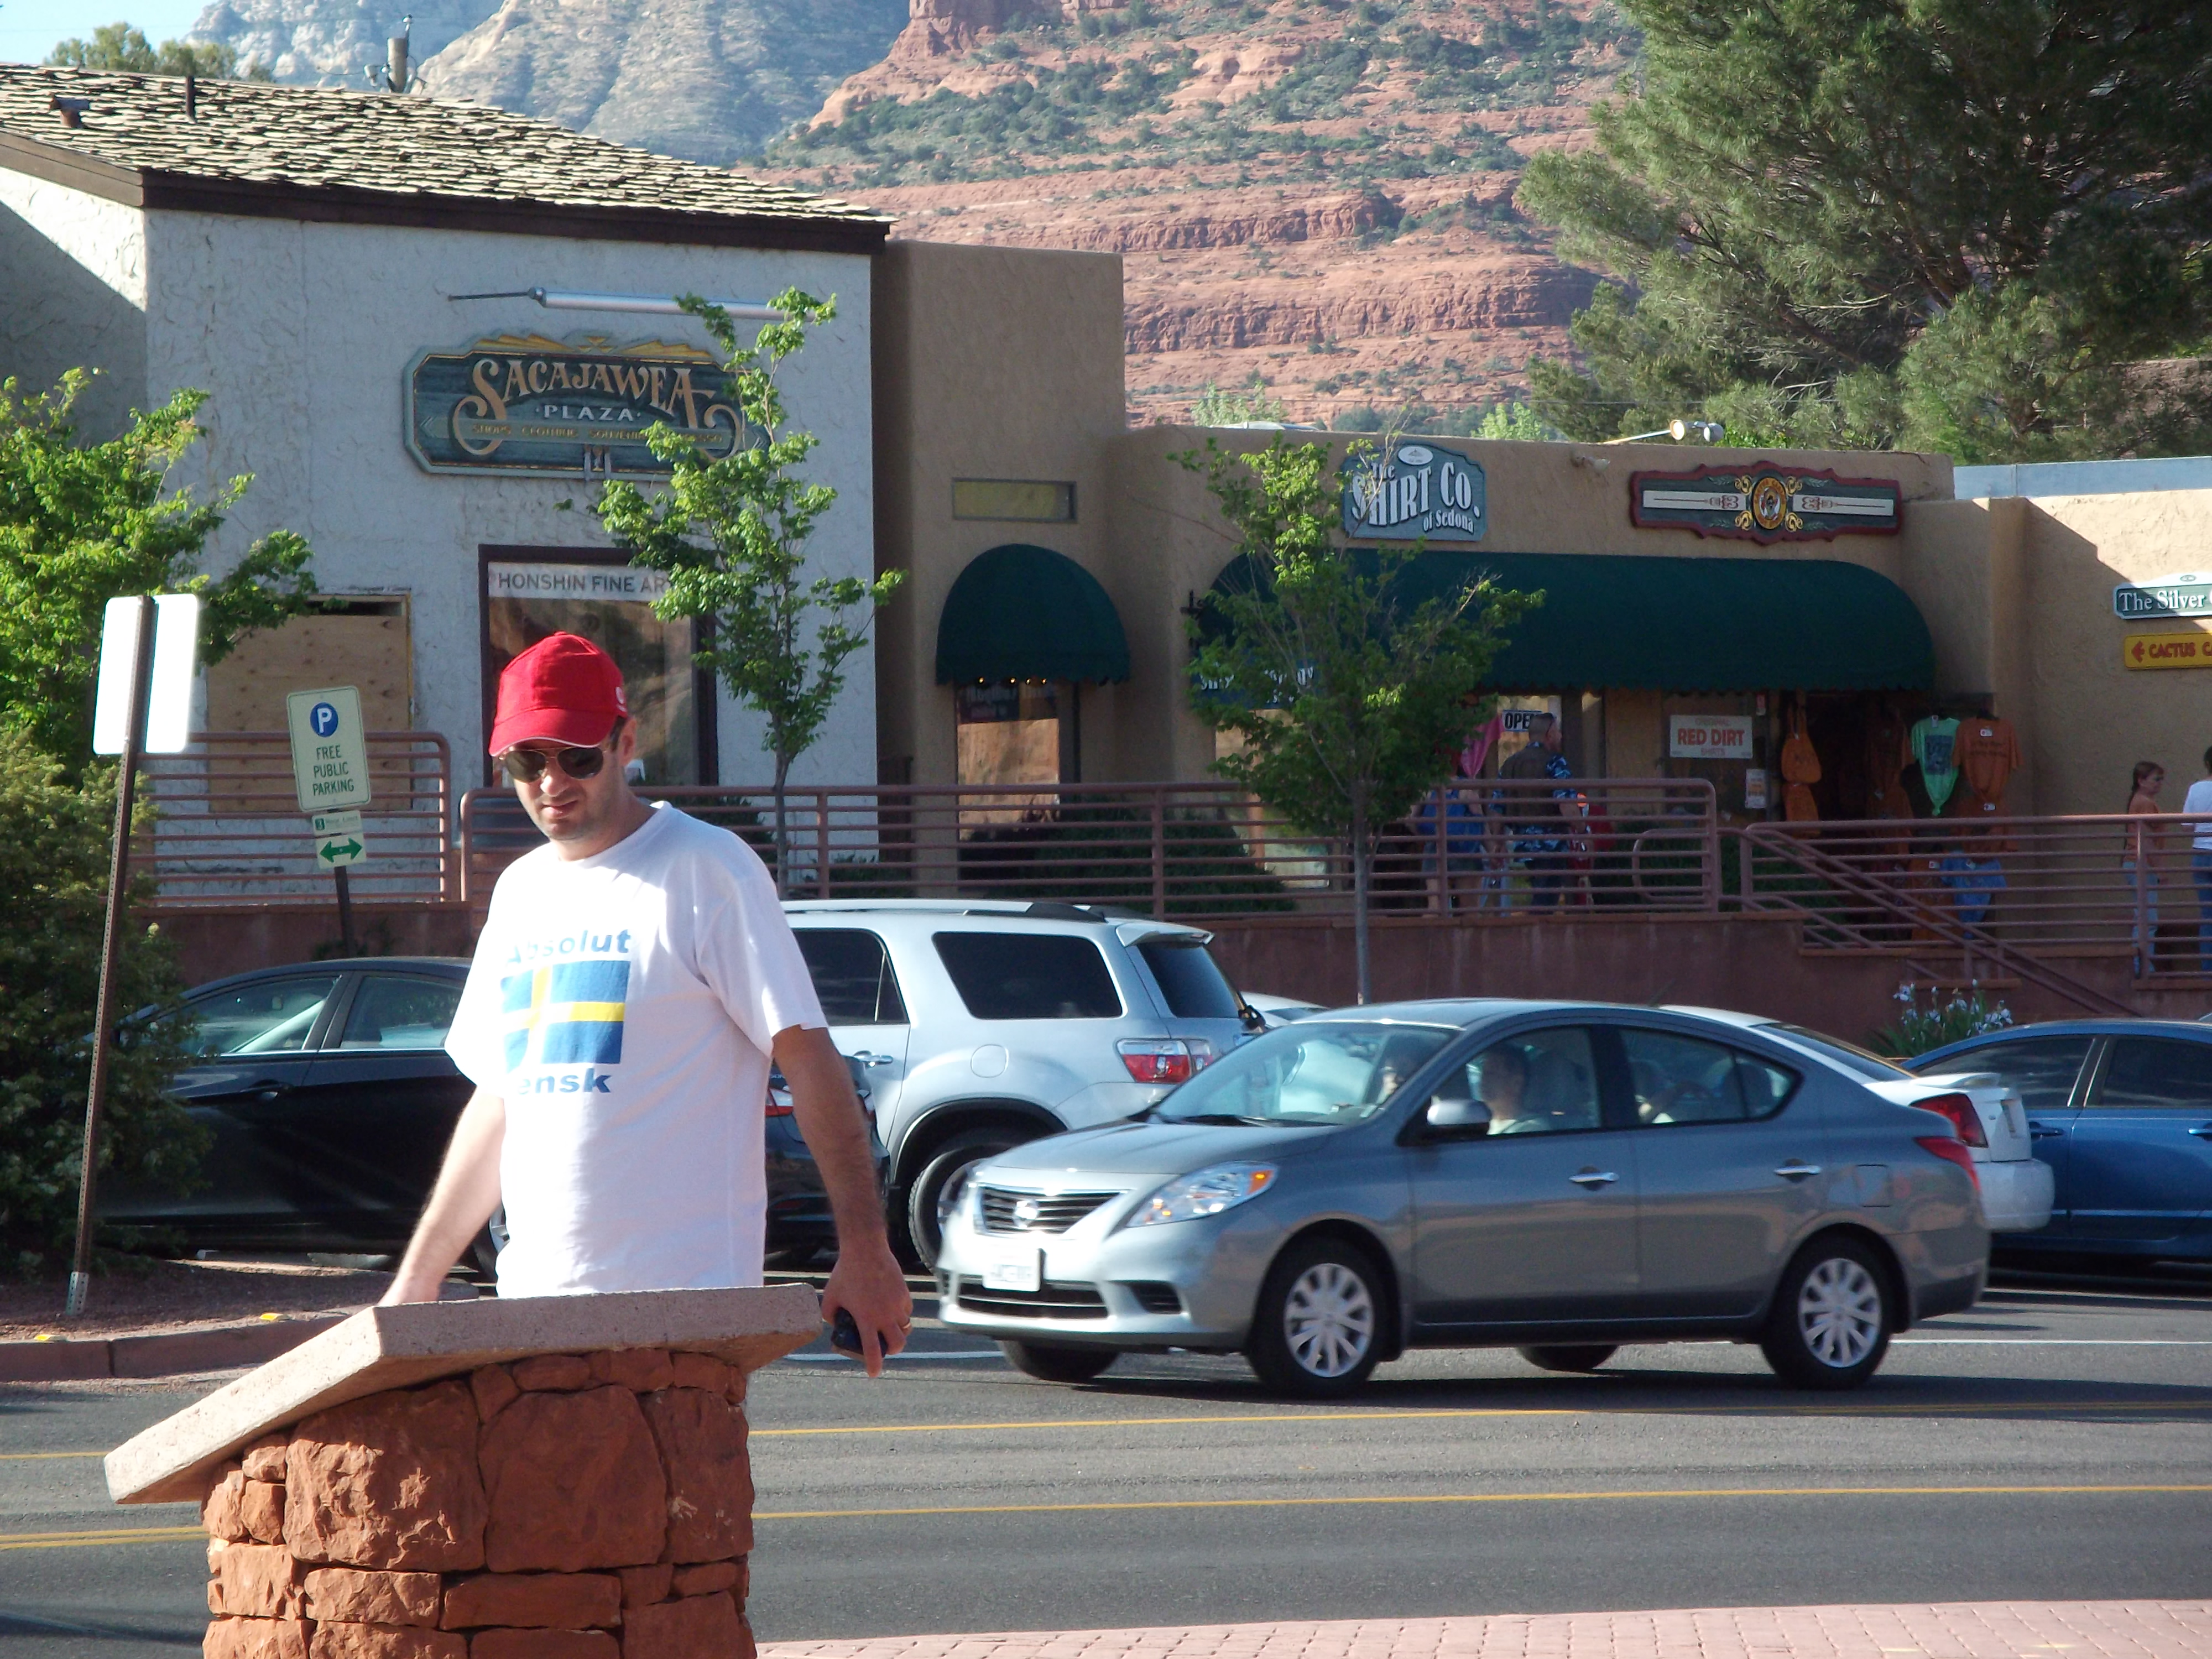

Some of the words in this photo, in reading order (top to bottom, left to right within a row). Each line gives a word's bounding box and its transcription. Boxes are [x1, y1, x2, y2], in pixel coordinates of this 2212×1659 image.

[453, 359, 717, 440] SACAJAWEA
[544, 404, 634, 422] PLAZA
[473, 423, 511, 435] SHOPS
[521, 425, 579, 439] CLOTHING
[588, 429, 648, 441] SOUVENIR
[1370, 462, 1395, 479] The
[1351, 466, 1432, 526] SHIRT
[1423, 512, 1433, 532] of
[1436, 509, 1474, 534] Sedona
[498, 572, 585, 591] HONSHIN
[592, 575, 634, 593] FINE
[640, 576, 668, 593] AR
[2119, 592, 2153, 612] The
[2157, 589, 2205, 609] Silver
[2148, 642, 2196, 658] CACTUS
[317, 708, 332, 734] P
[1504, 712, 1540, 729] OPE
[1677, 728, 1707, 745] RED
[1711, 728, 1745, 746] DIRT
[316, 745, 342, 760] FREE
[313, 761, 349, 778] PUBLIC
[312, 779, 354, 797] PARKING
[505, 928, 631, 967] Absolut
[518, 1068, 612, 1095] ensk
